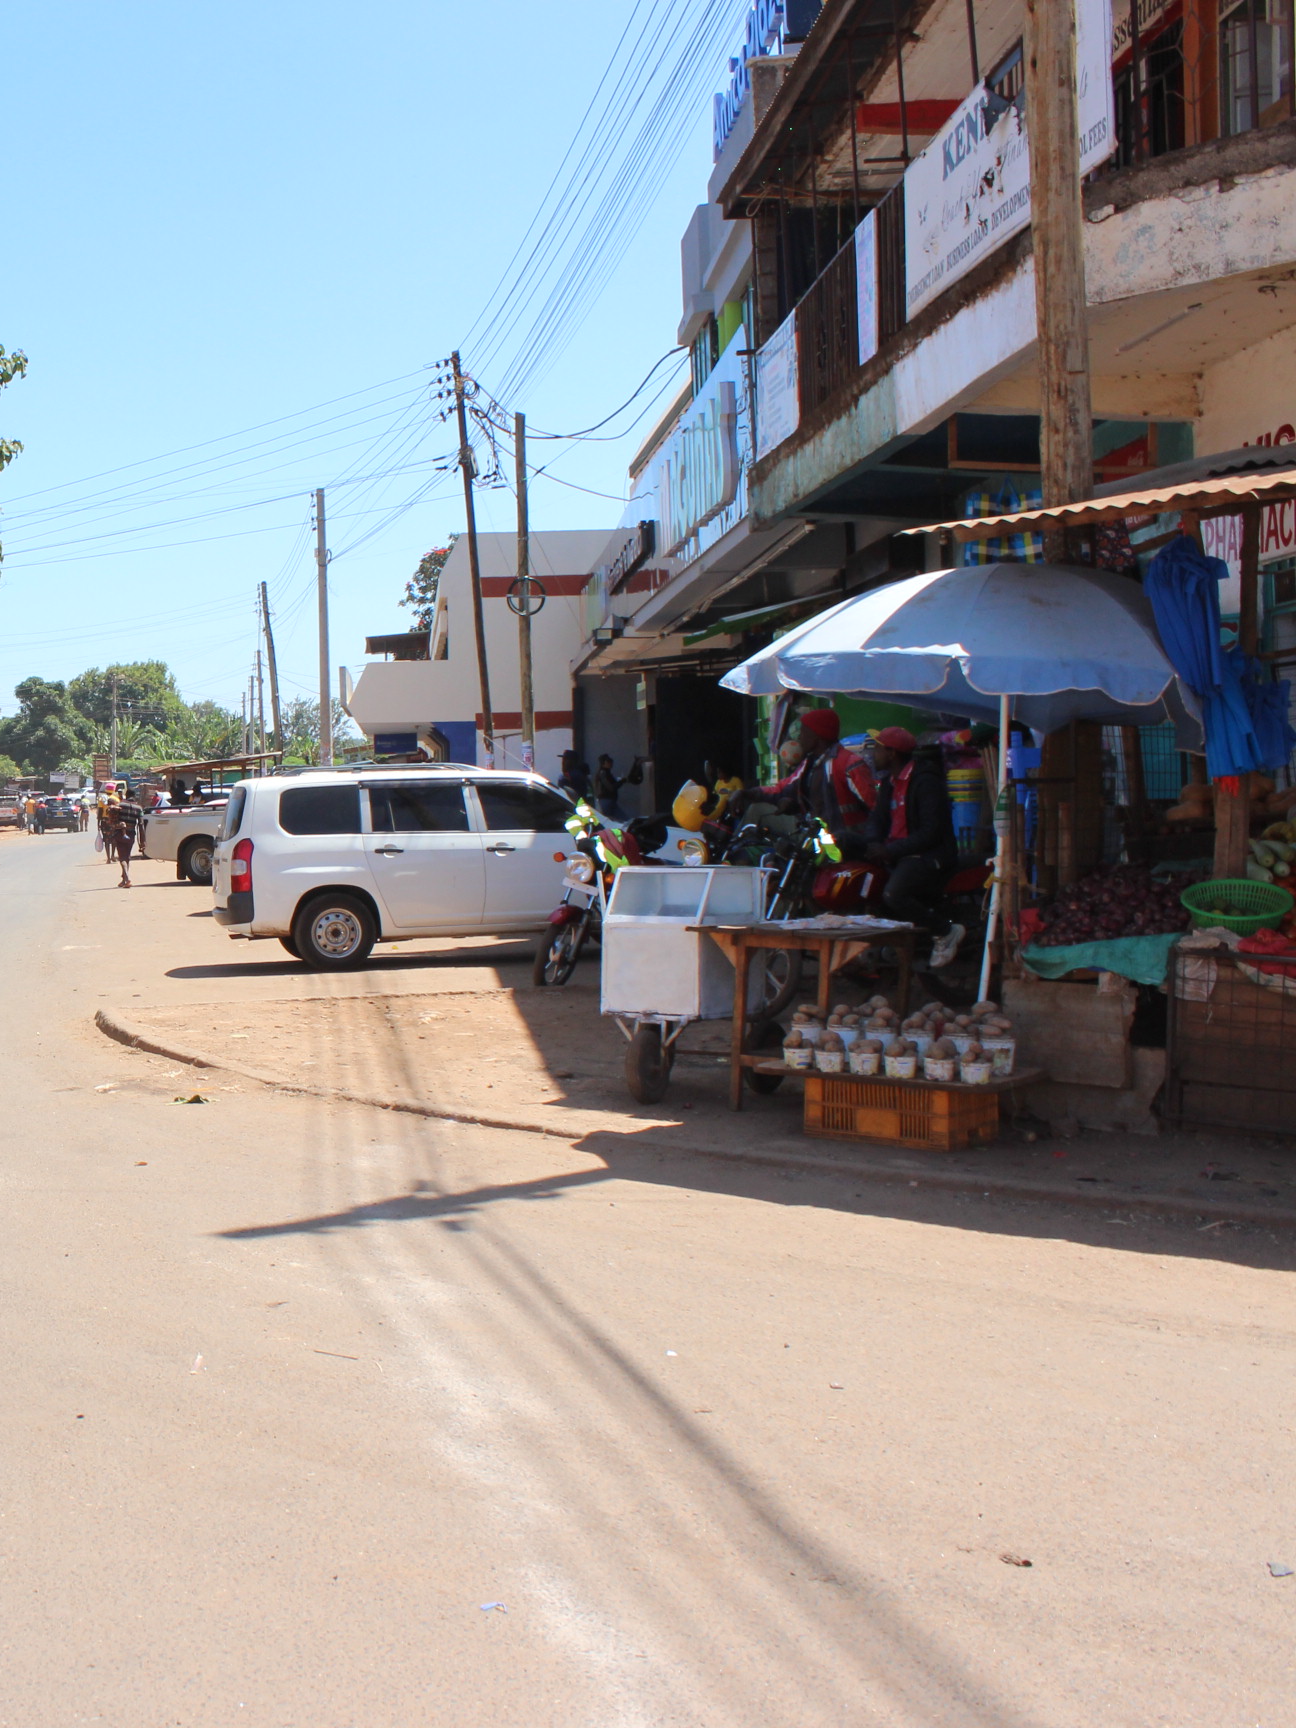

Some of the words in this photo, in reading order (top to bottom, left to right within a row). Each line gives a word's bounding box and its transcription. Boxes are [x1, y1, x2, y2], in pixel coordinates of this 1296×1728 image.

[946, 236, 970, 273] BUSINESS
[971, 217, 988, 251] LOANS
[991, 184, 1030, 231] DEVELOPMEN
[1088, 117, 1107, 147] FEES
